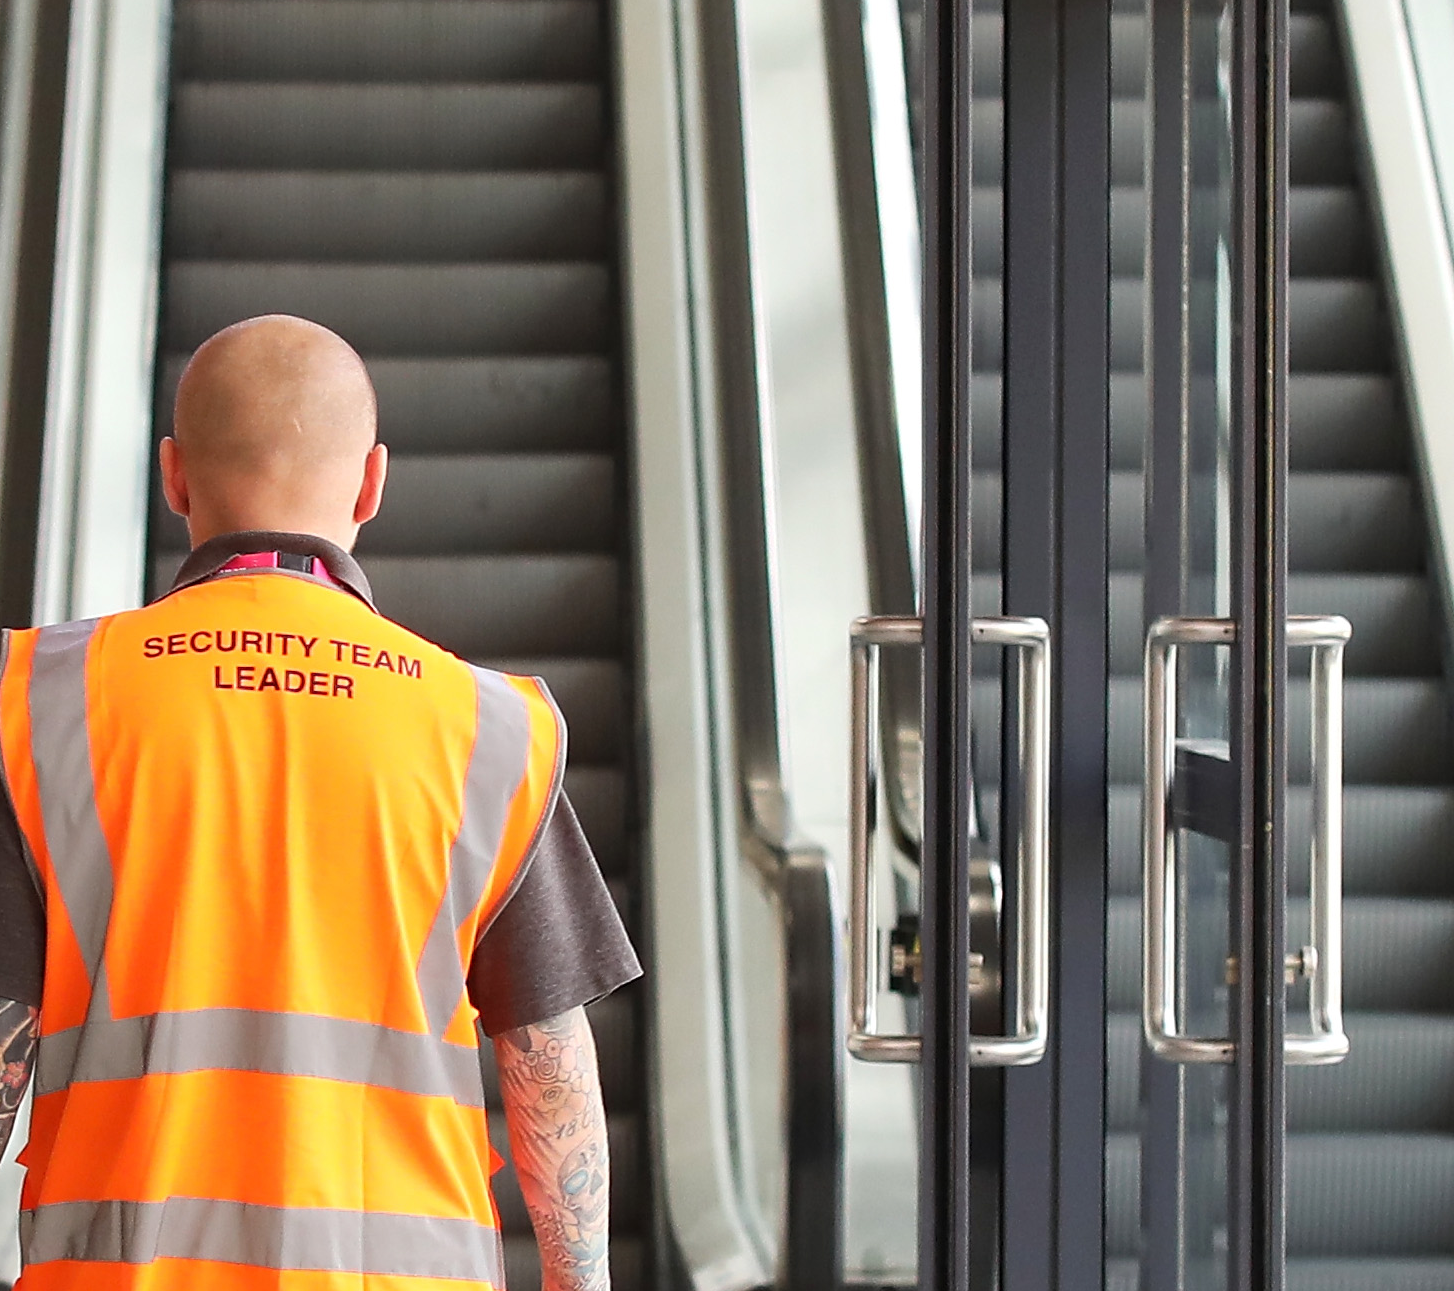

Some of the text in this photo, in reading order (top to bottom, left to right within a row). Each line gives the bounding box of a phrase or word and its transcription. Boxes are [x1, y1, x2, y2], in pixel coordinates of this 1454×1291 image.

[143, 629, 422, 679] SECURITY TEAM
[214, 665, 355, 699] LEADER
